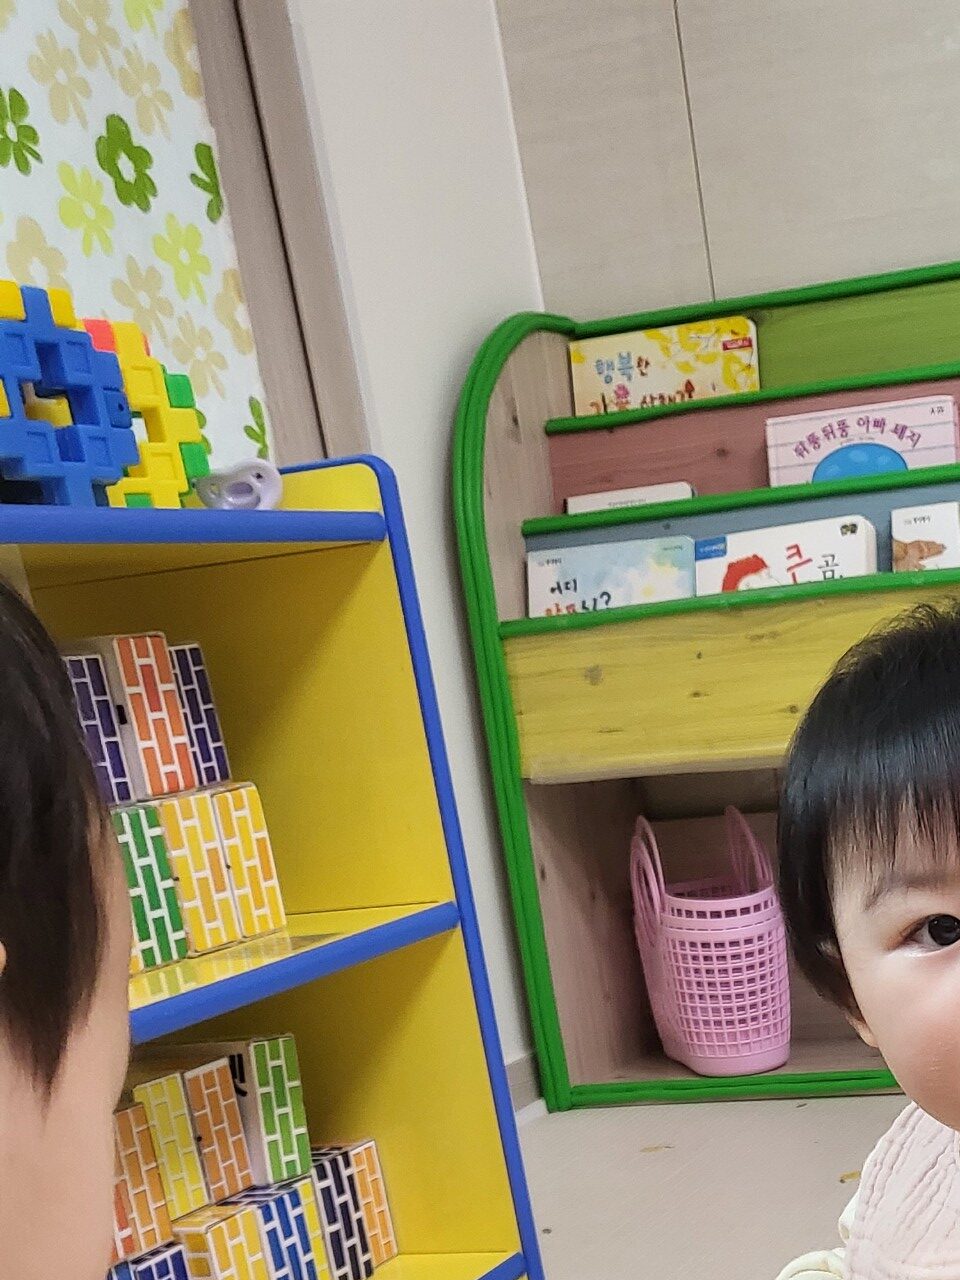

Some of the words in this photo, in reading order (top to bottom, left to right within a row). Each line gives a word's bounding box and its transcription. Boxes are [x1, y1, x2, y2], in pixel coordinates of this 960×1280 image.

[595, 351, 650, 384] 행복한
[856, 415, 887, 435] 아빠
[890, 423, 921, 449] 돼지
[550, 578, 577, 594] 어디
